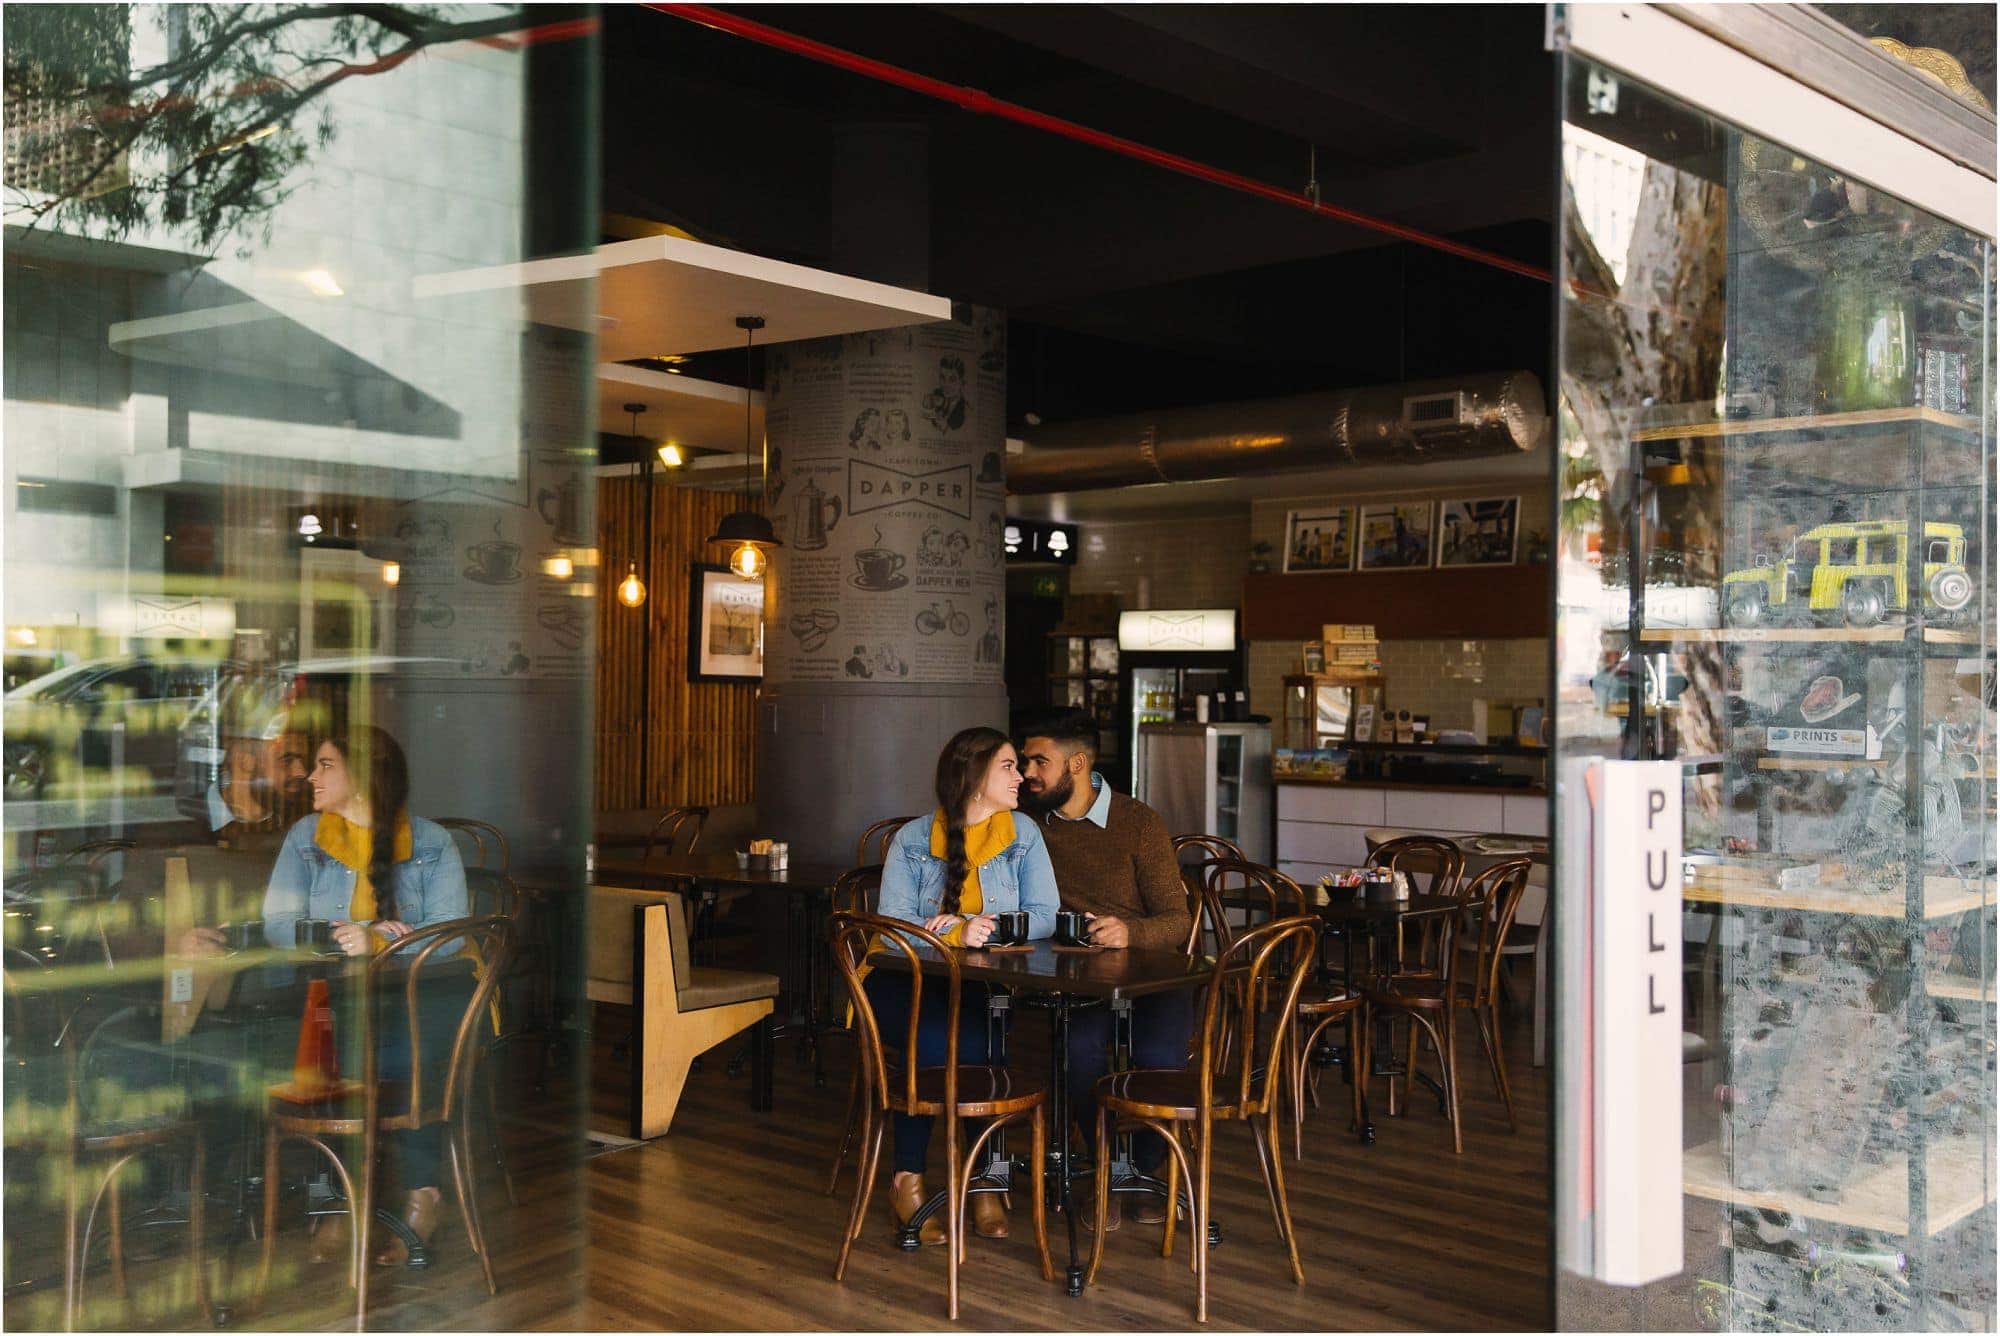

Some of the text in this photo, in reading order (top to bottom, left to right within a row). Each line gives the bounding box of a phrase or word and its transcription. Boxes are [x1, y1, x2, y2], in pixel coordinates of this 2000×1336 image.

[861, 480, 962, 498] DAPPER
[1793, 730, 1838, 742] PRINTS
[1646, 789, 1668, 1015] PULL
